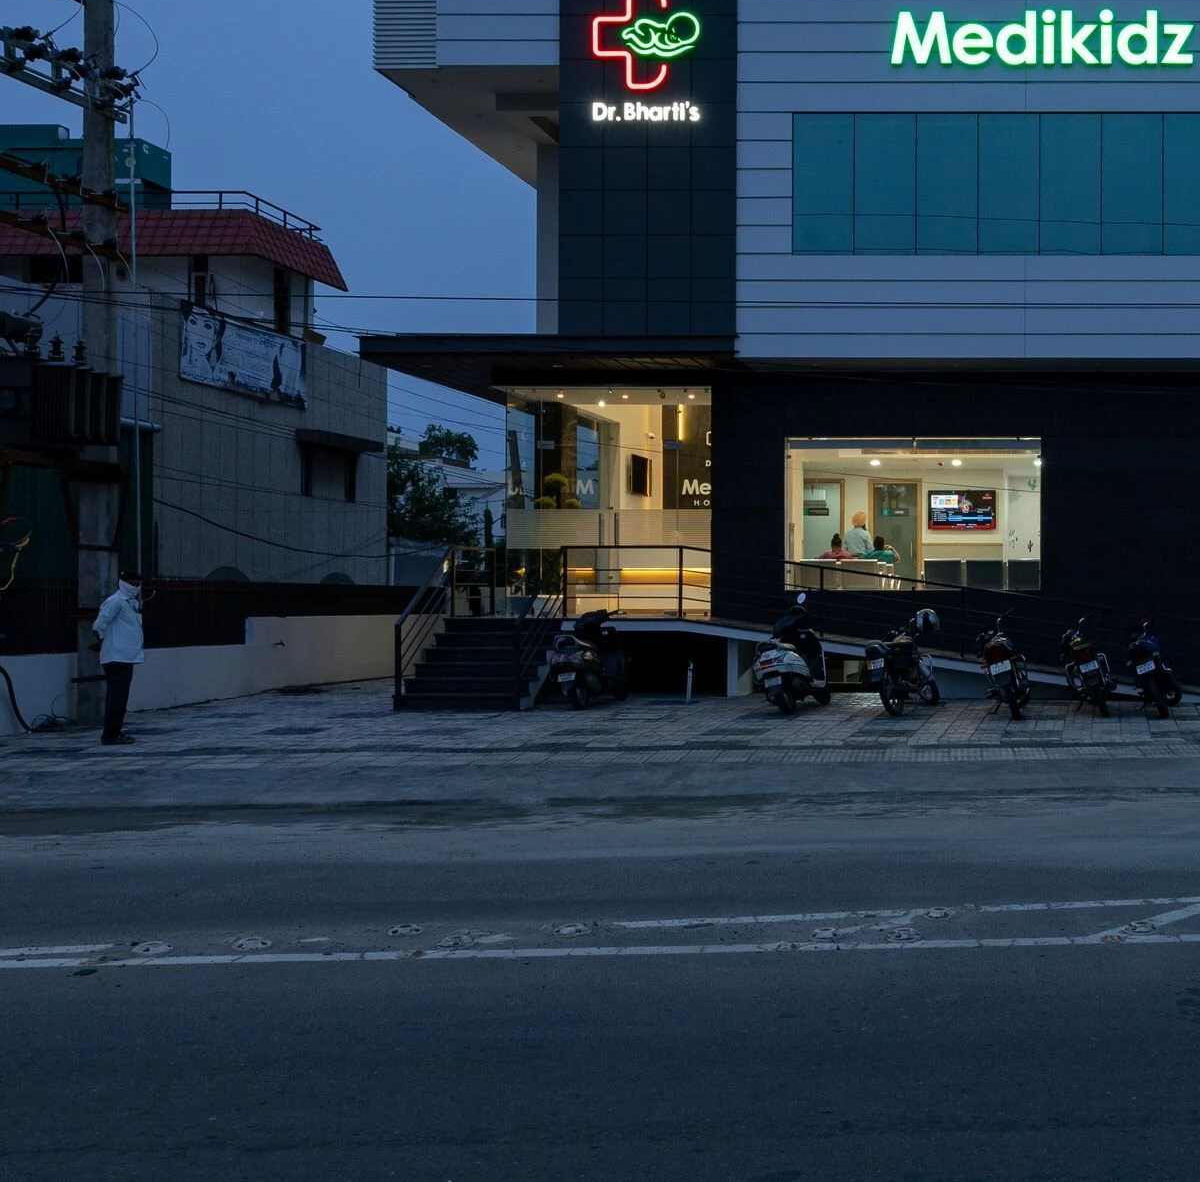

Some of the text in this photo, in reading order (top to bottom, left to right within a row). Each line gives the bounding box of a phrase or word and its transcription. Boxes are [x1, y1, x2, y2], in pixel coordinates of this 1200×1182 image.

[890, 9, 1194, 65] Medikidz
[592, 101, 700, 122] Dr. Bharti's
